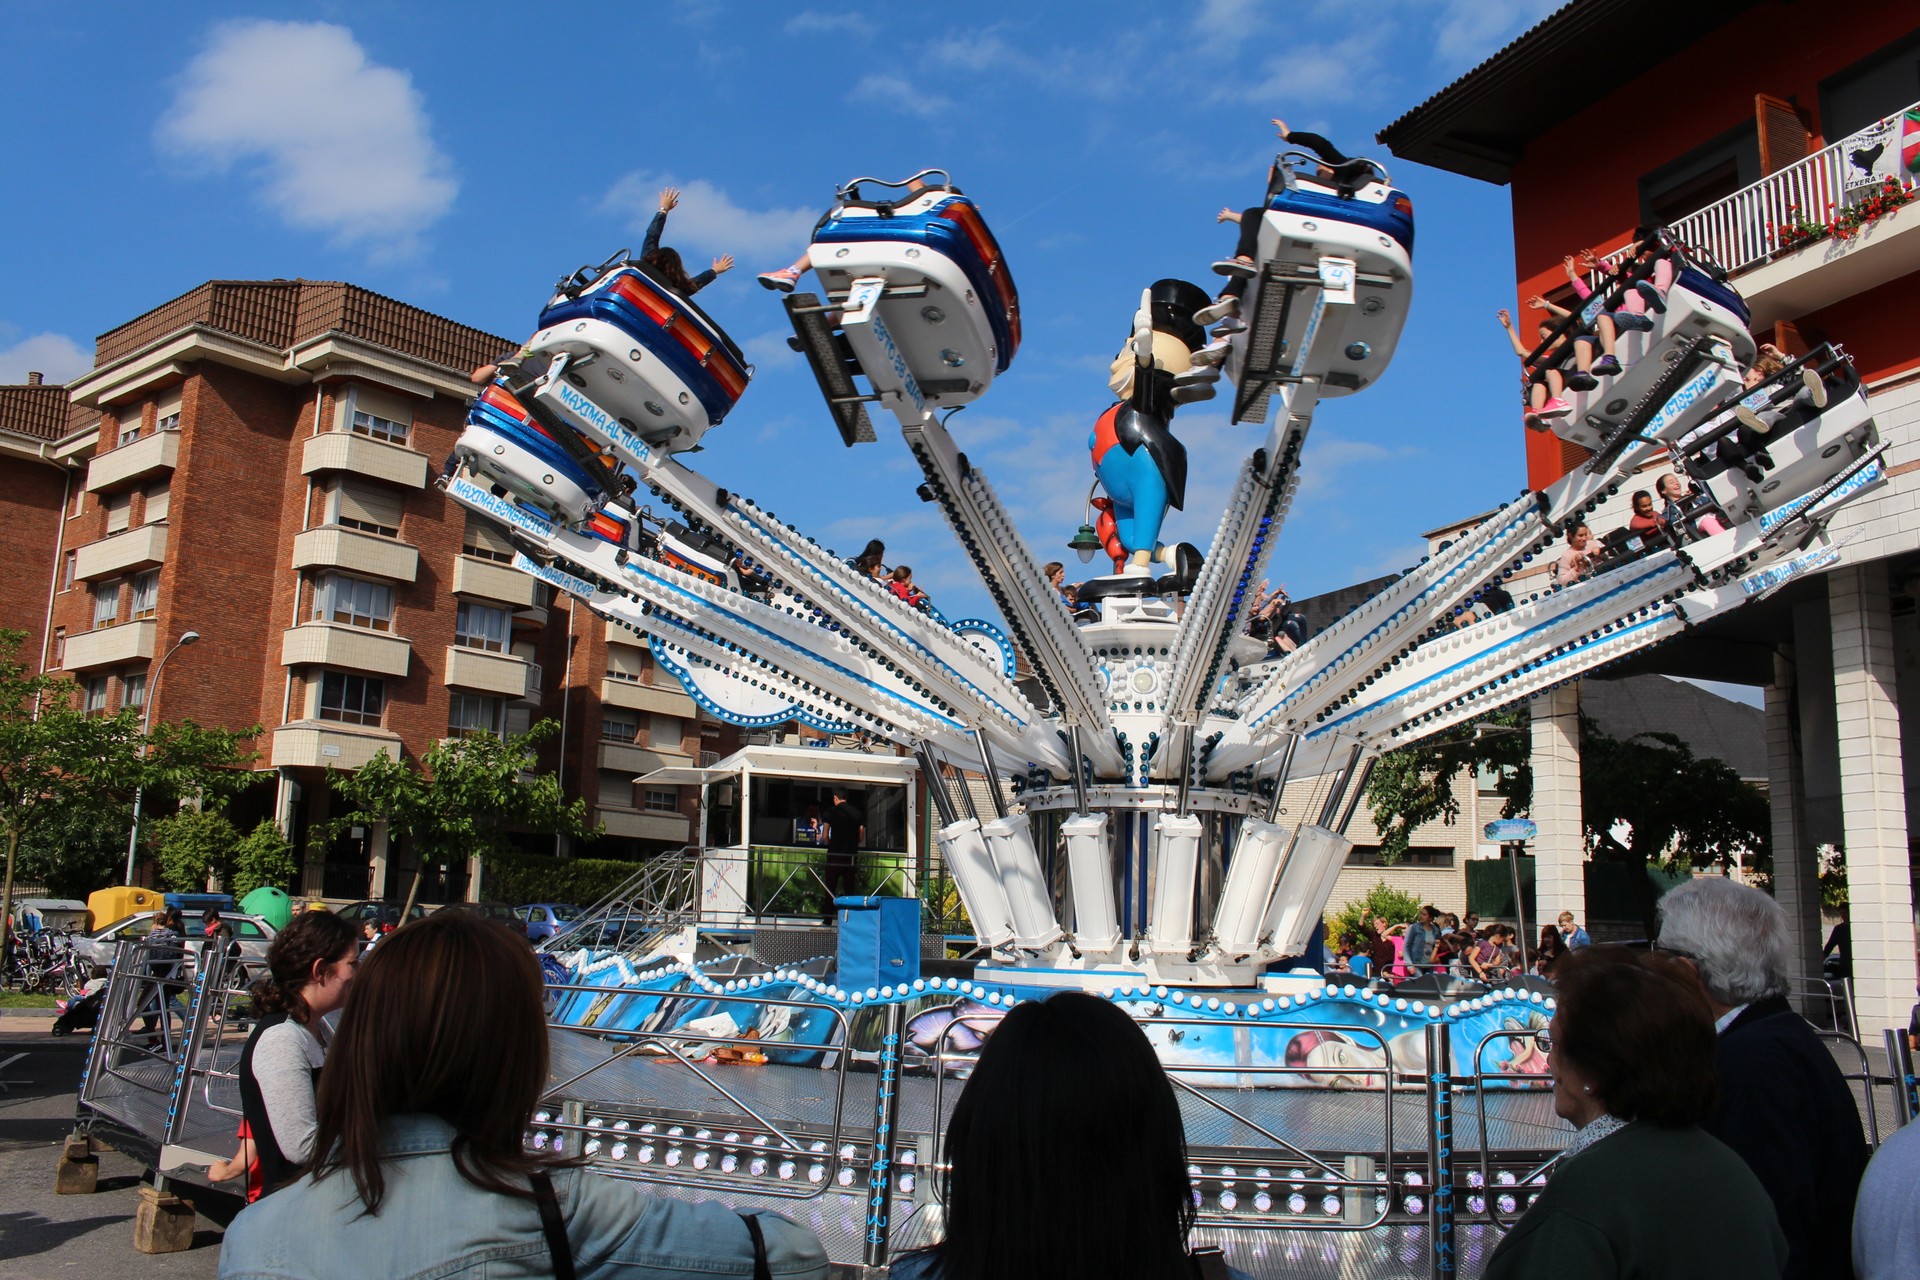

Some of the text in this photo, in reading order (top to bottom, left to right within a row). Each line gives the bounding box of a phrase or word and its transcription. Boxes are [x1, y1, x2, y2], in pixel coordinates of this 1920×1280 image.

[1845, 176, 1876, 190] ETXERA
[1664, 369, 1717, 418] FIESTAS
[560, 385, 651, 462] MAXIMA ALTURA
[453, 479, 554, 538] MAXIMA SENSACION
